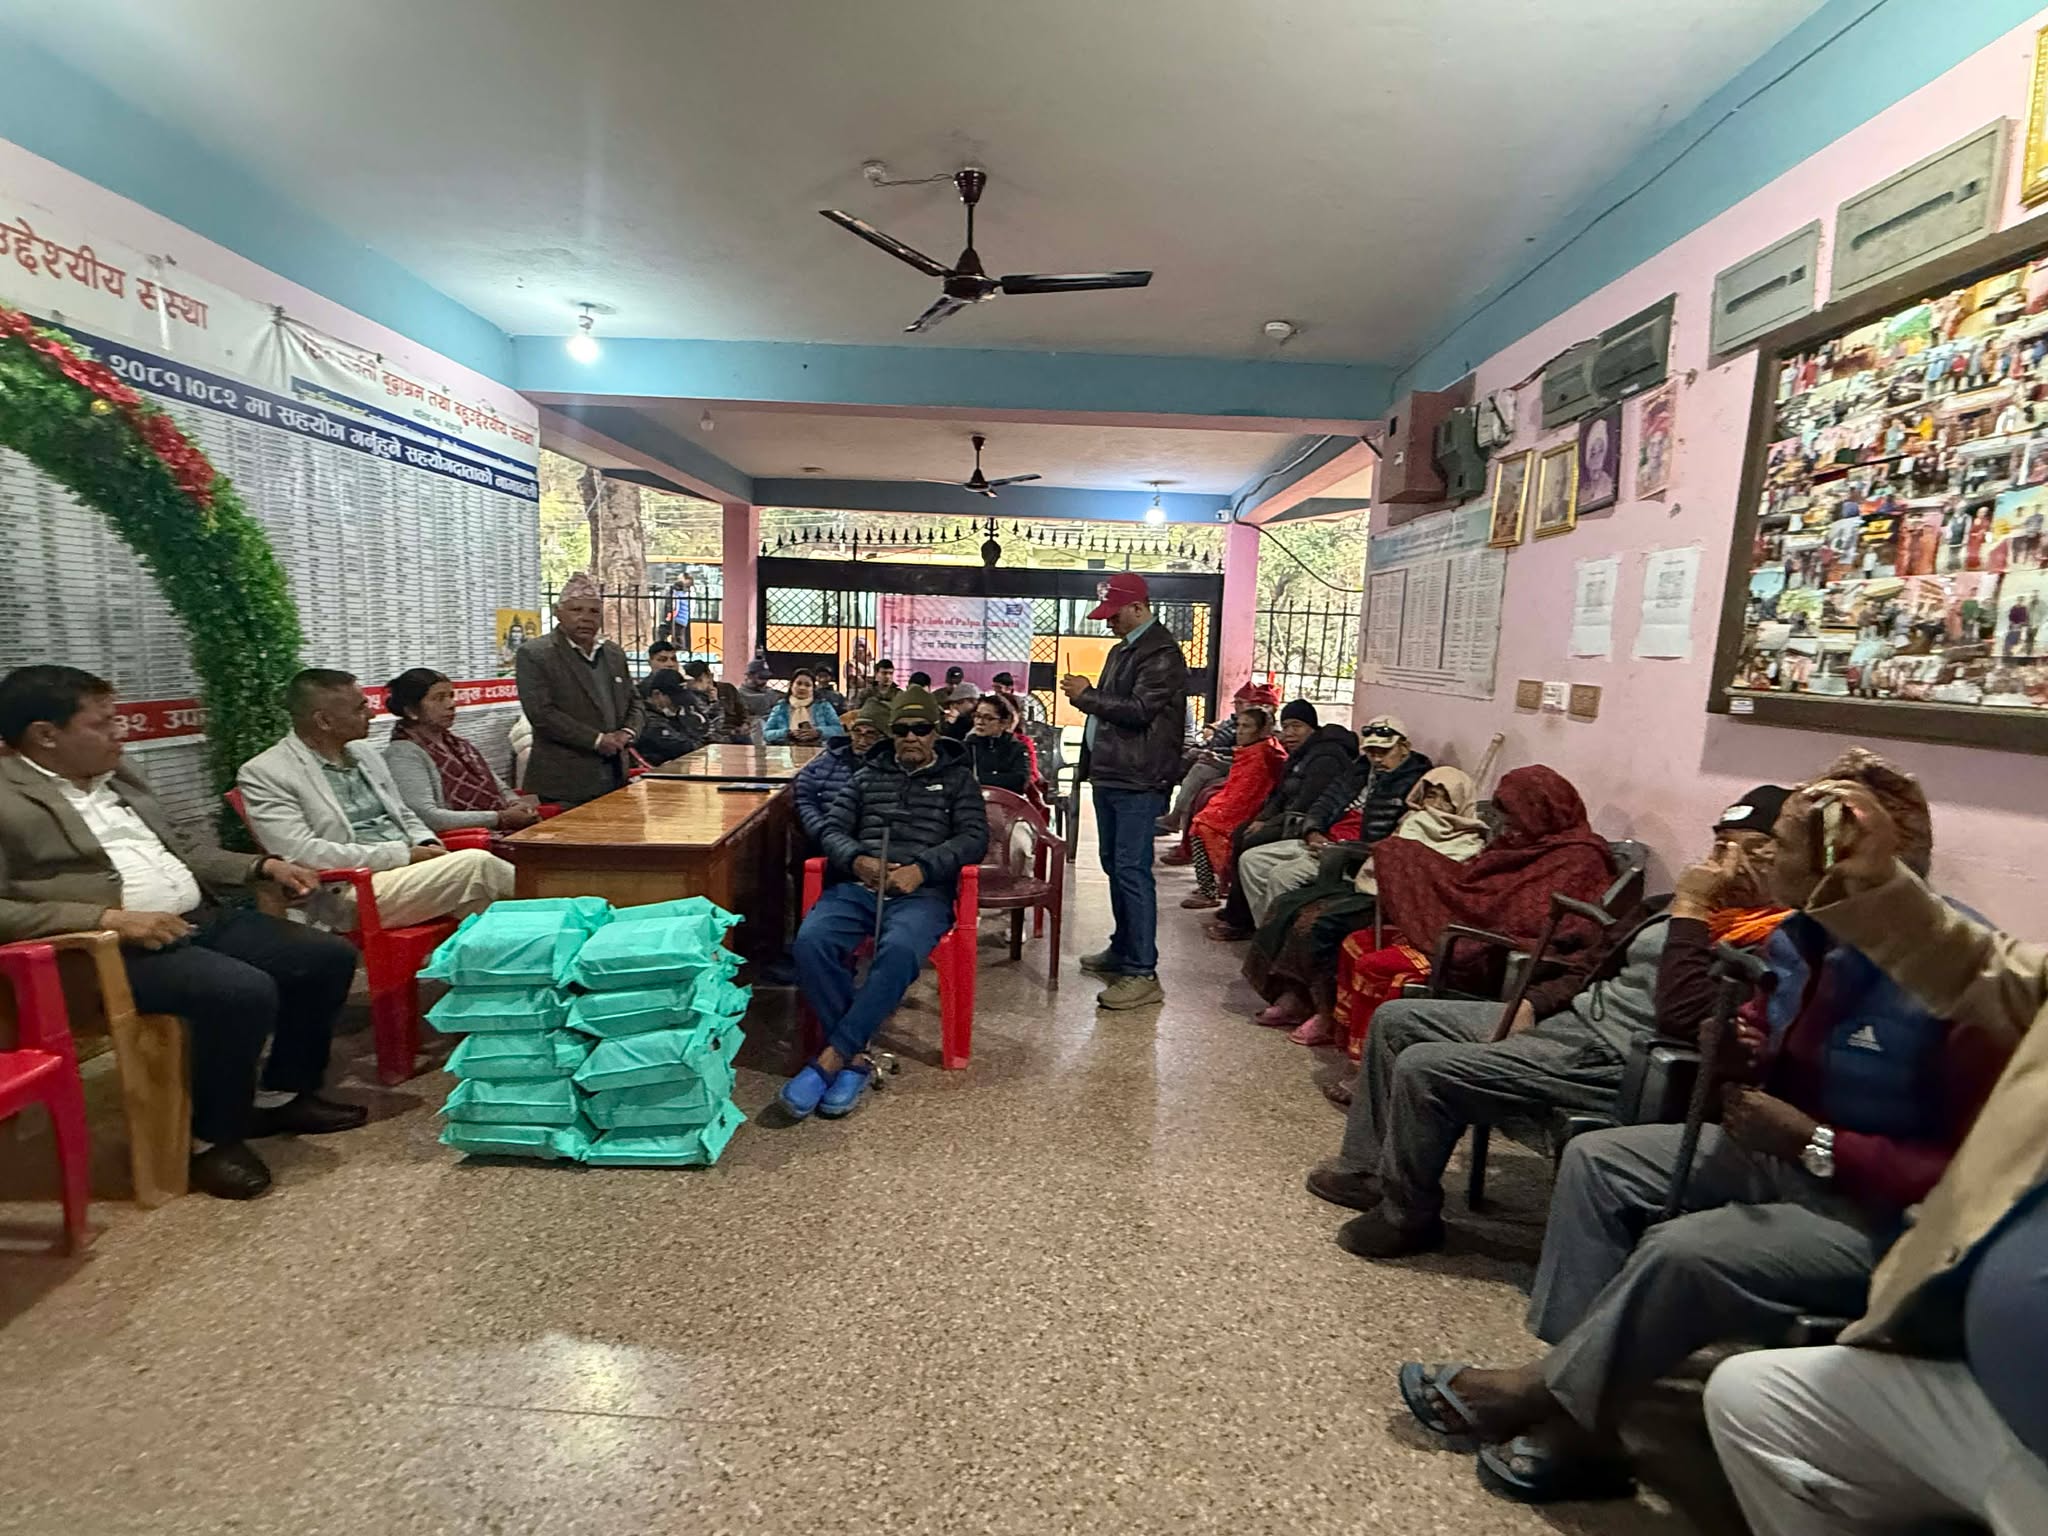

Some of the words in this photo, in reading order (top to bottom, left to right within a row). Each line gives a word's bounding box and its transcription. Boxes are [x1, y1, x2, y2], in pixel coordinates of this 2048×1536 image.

[244, 395, 272, 419] मा
[276, 404, 347, 441] सहयोग
[349, 430, 402, 459] गर्नुहुने
[404, 445, 494, 486] सहयोगदाताको
